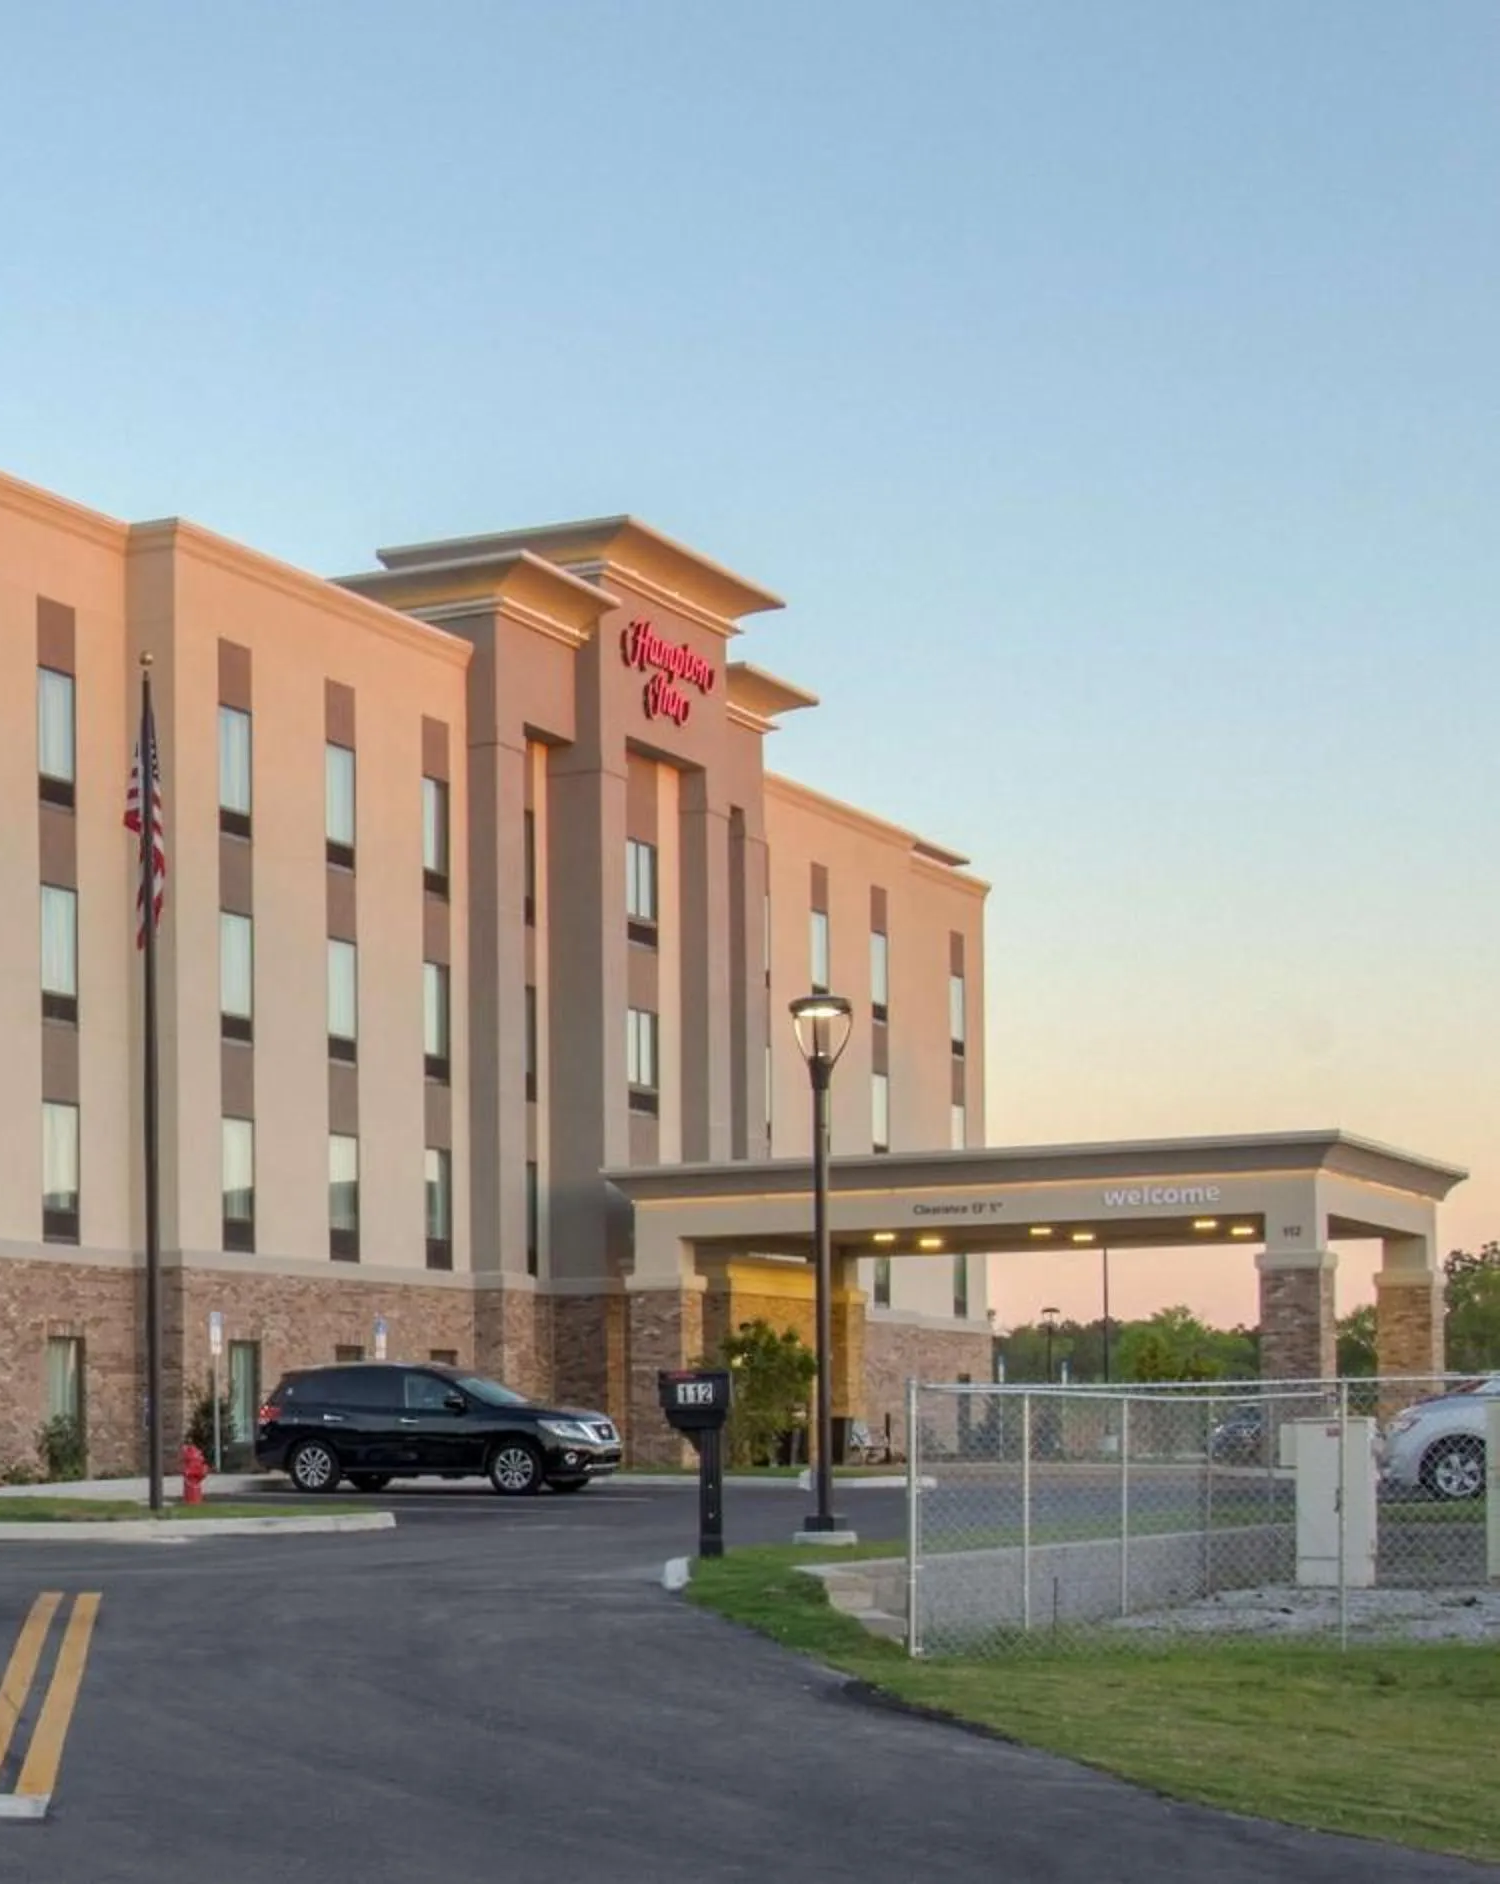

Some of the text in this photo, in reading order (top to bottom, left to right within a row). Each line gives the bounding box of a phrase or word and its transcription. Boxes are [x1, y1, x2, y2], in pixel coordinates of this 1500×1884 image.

[620, 618, 714, 694] Hampton
[643, 672, 689, 727] Inn
[1103, 1184, 1221, 1206] welcome
[678, 1383, 713, 1404] 112
